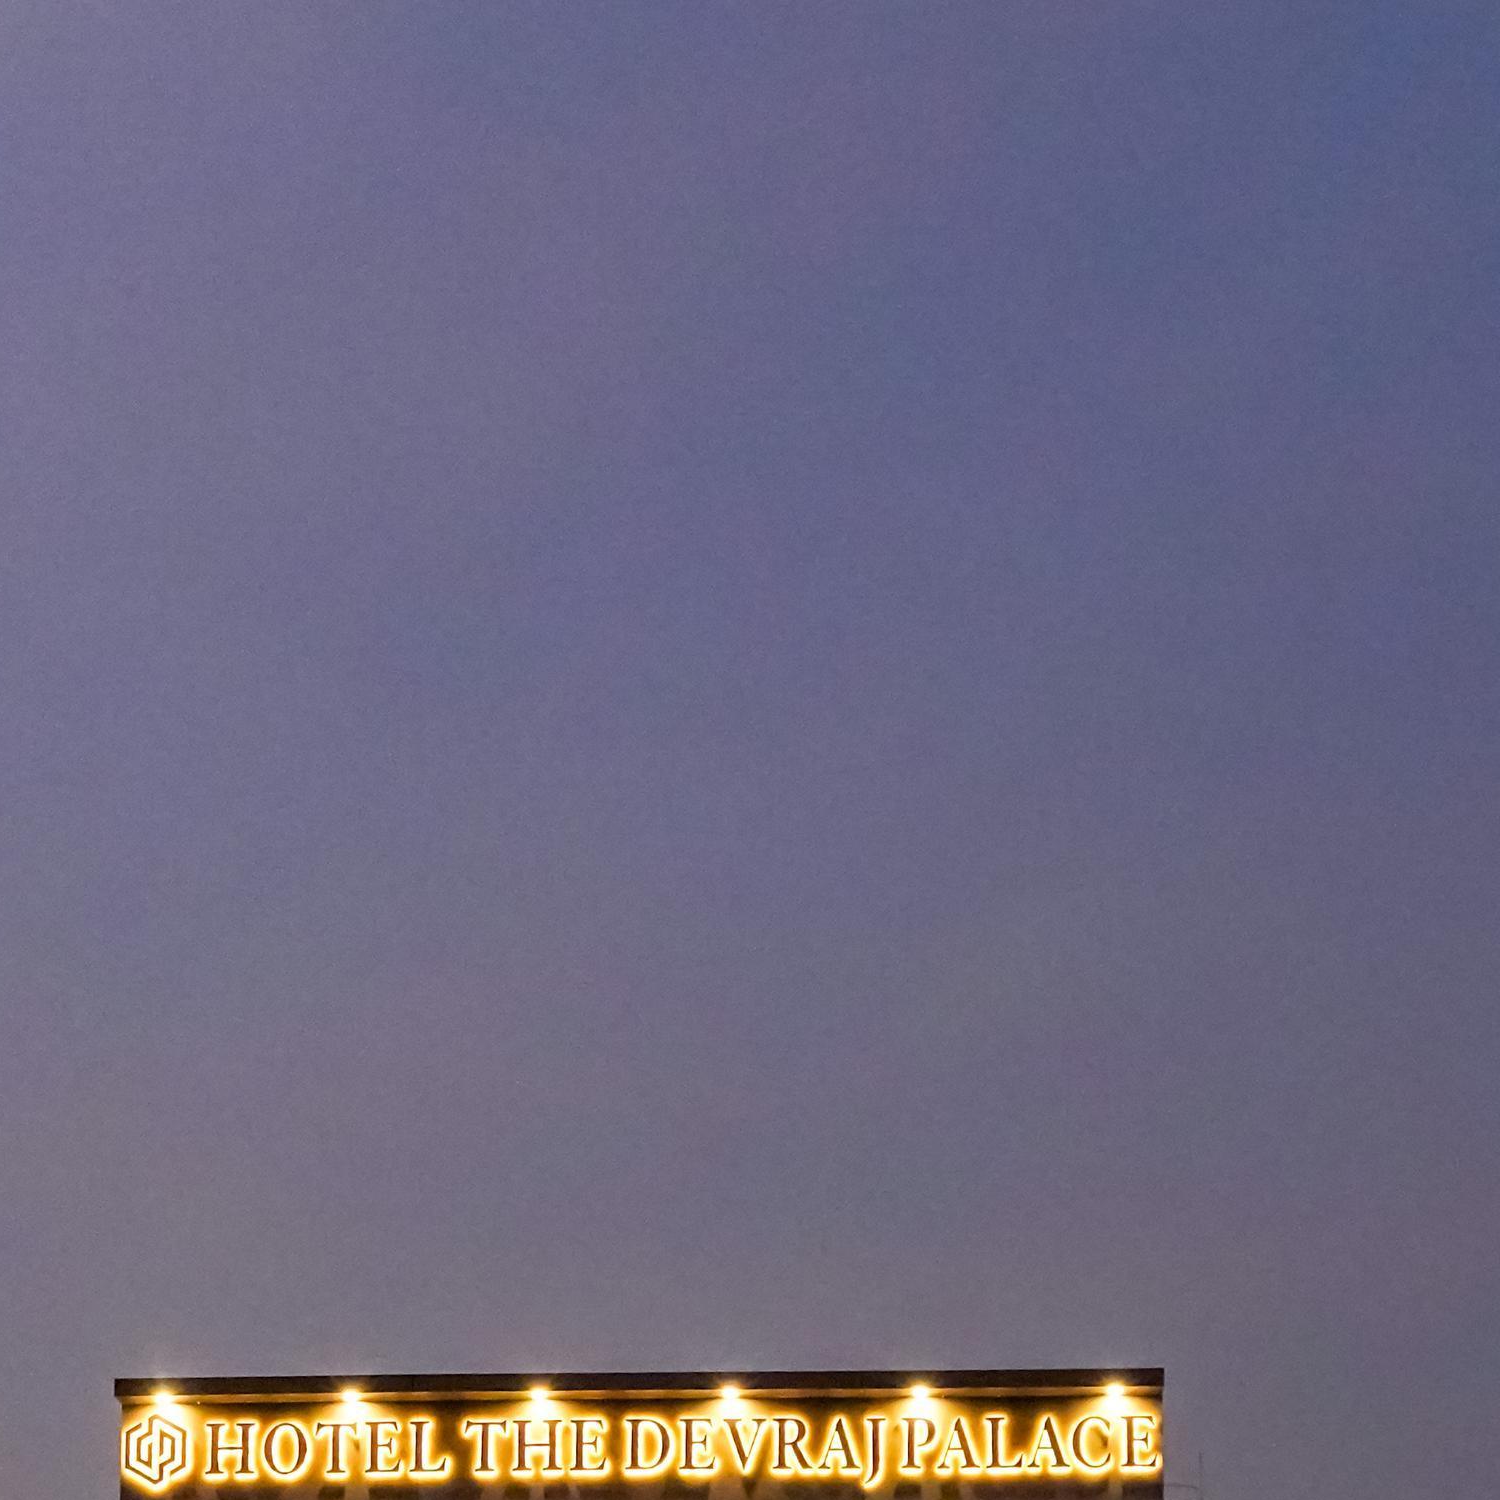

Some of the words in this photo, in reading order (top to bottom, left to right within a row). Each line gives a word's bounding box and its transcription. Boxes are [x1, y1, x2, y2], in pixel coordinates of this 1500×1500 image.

[204, 1420, 447, 1475] HOTEL
[464, 1418, 607, 1472] THE
[624, 1416, 882, 1486] DEVRAJ
[900, 1414, 1162, 1470] PALACE
